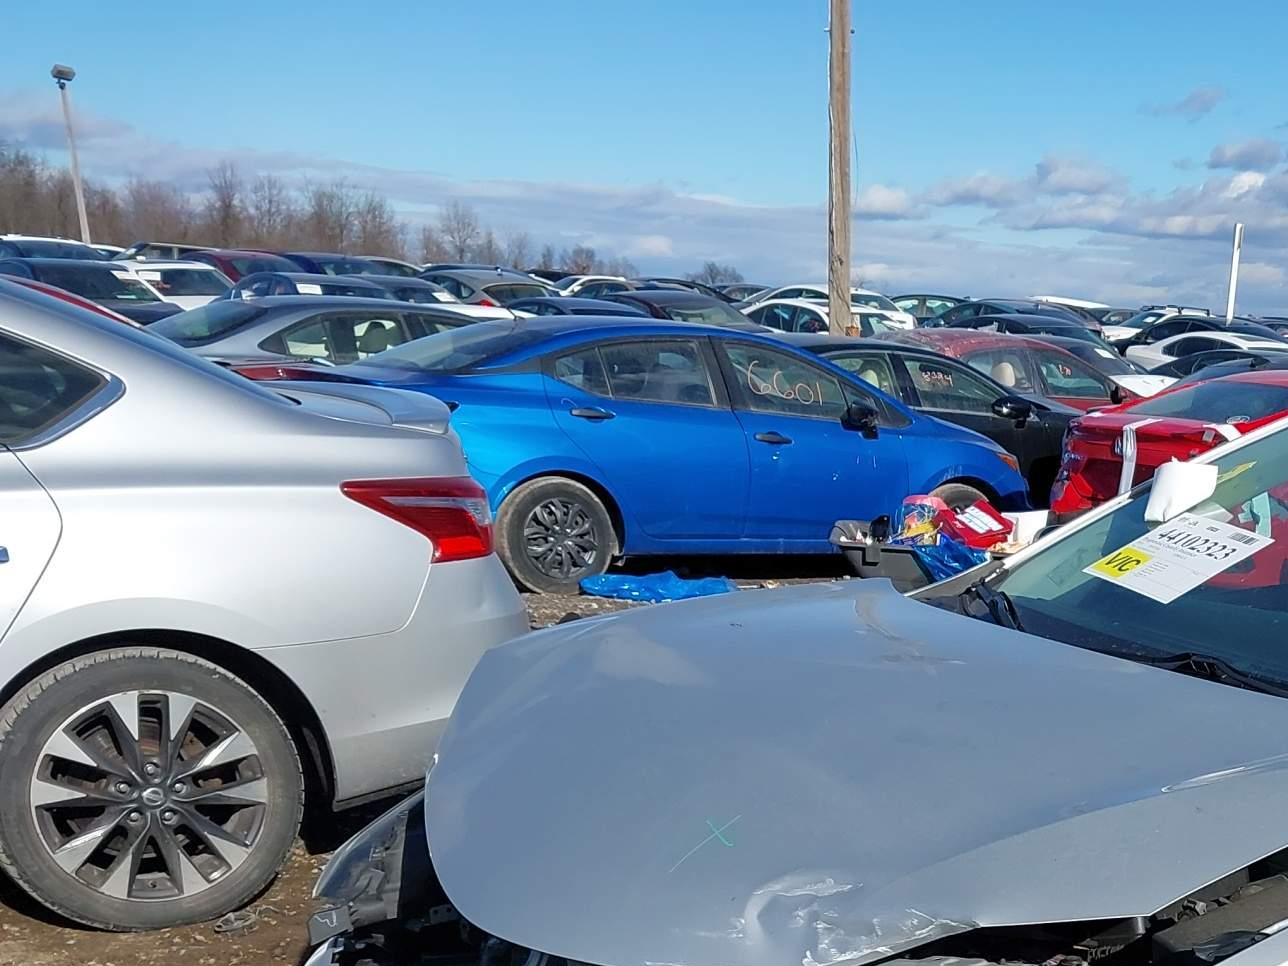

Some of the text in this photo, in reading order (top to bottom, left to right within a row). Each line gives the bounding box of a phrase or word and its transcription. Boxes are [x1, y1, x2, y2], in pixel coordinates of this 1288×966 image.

[747, 360, 823, 407] 6601
[1158, 528, 1237, 560] 44102323
[1105, 552, 1141, 572] VIC
